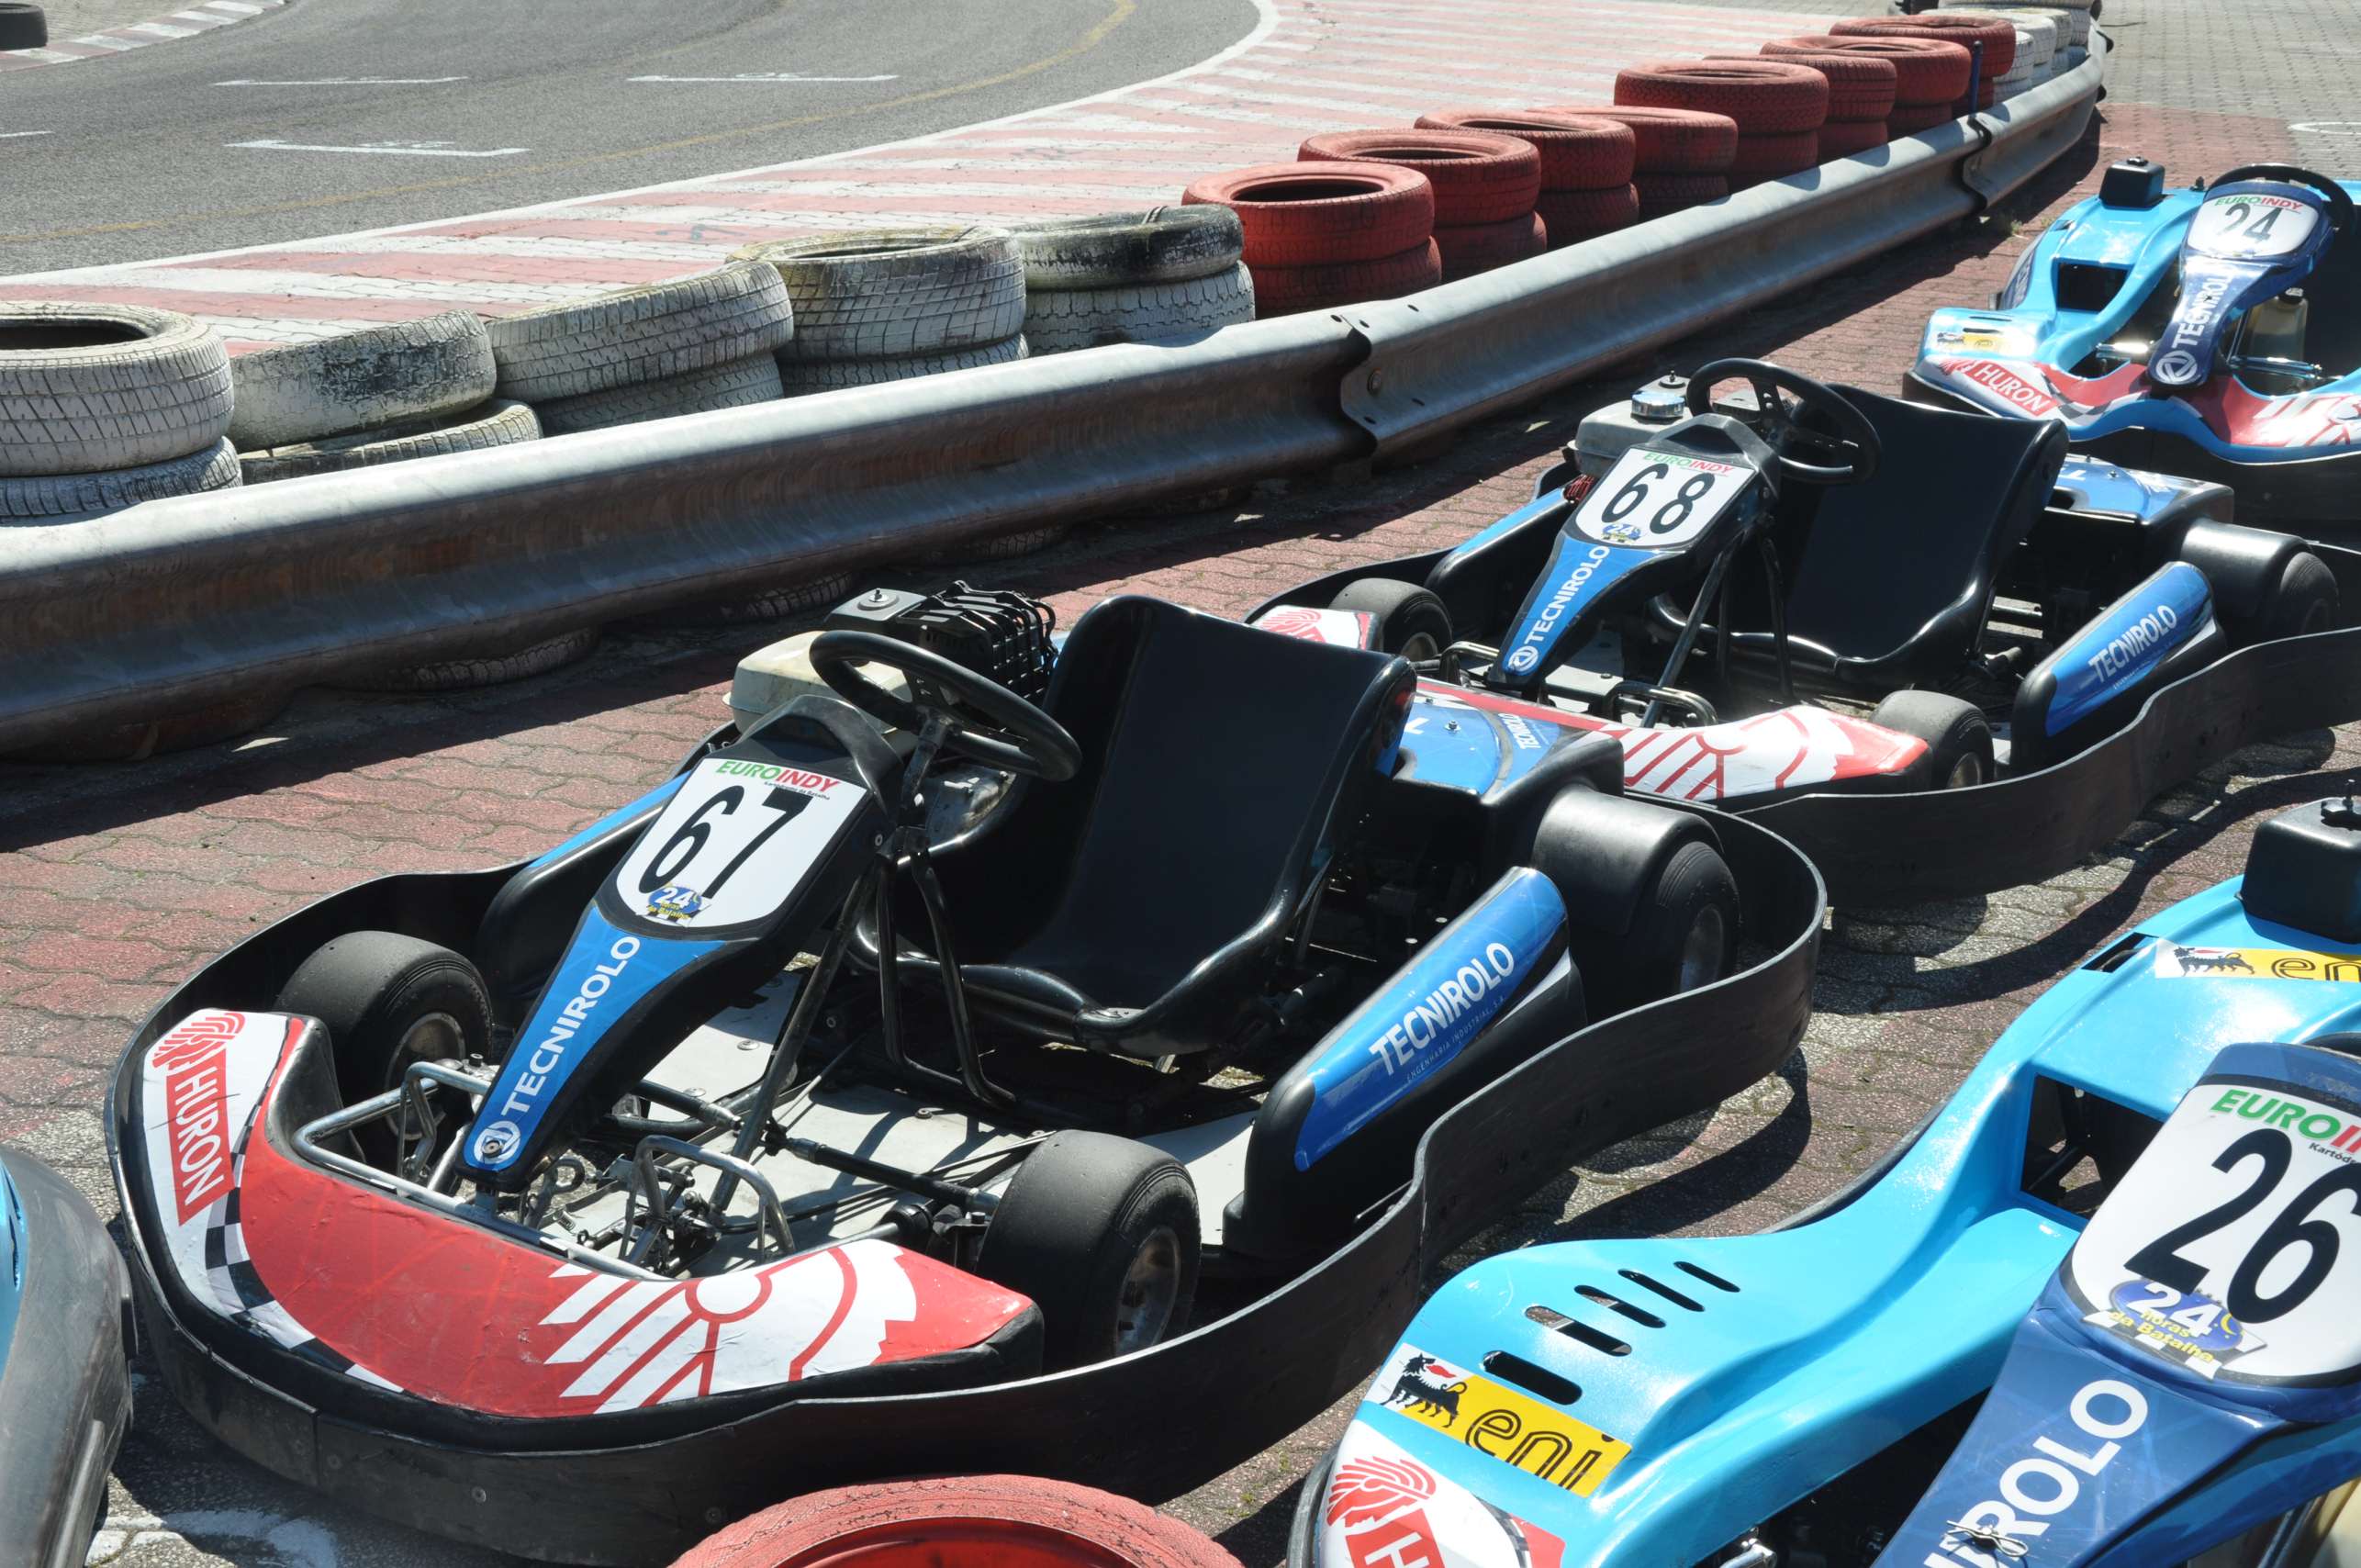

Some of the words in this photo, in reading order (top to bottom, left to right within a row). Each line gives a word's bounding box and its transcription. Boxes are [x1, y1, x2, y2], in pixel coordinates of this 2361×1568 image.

[2214, 196, 2304, 210] EUROINDY
[2218, 203, 2284, 243] 24
[2172, 274, 2233, 349] TECNIROL
[1975, 364, 2052, 412] HURON
[1601, 463, 1716, 534] 68
[1644, 452, 1734, 474] EUROINDY
[1525, 545, 1610, 644] TECNIROLO
[2087, 605, 2176, 683] TECNIROLO
[716, 760, 839, 792] EUROINDY
[637, 785, 814, 900] 67
[654, 887, 695, 909] 24
[501, 935, 641, 1115] TECNIROLO
[1369, 943, 1514, 1076] TECNIROLO
[174, 1066, 225, 1206] HURON
[2122, 1128, 2361, 1324] 26
[2109, 1310, 2135, 1328] da
[2136, 1320, 2214, 1364] Batalha
[2126, 1282, 2224, 1338] 24
[2139, 1309, 2191, 1338] horas
[1464, 1407, 1613, 1493] eni
